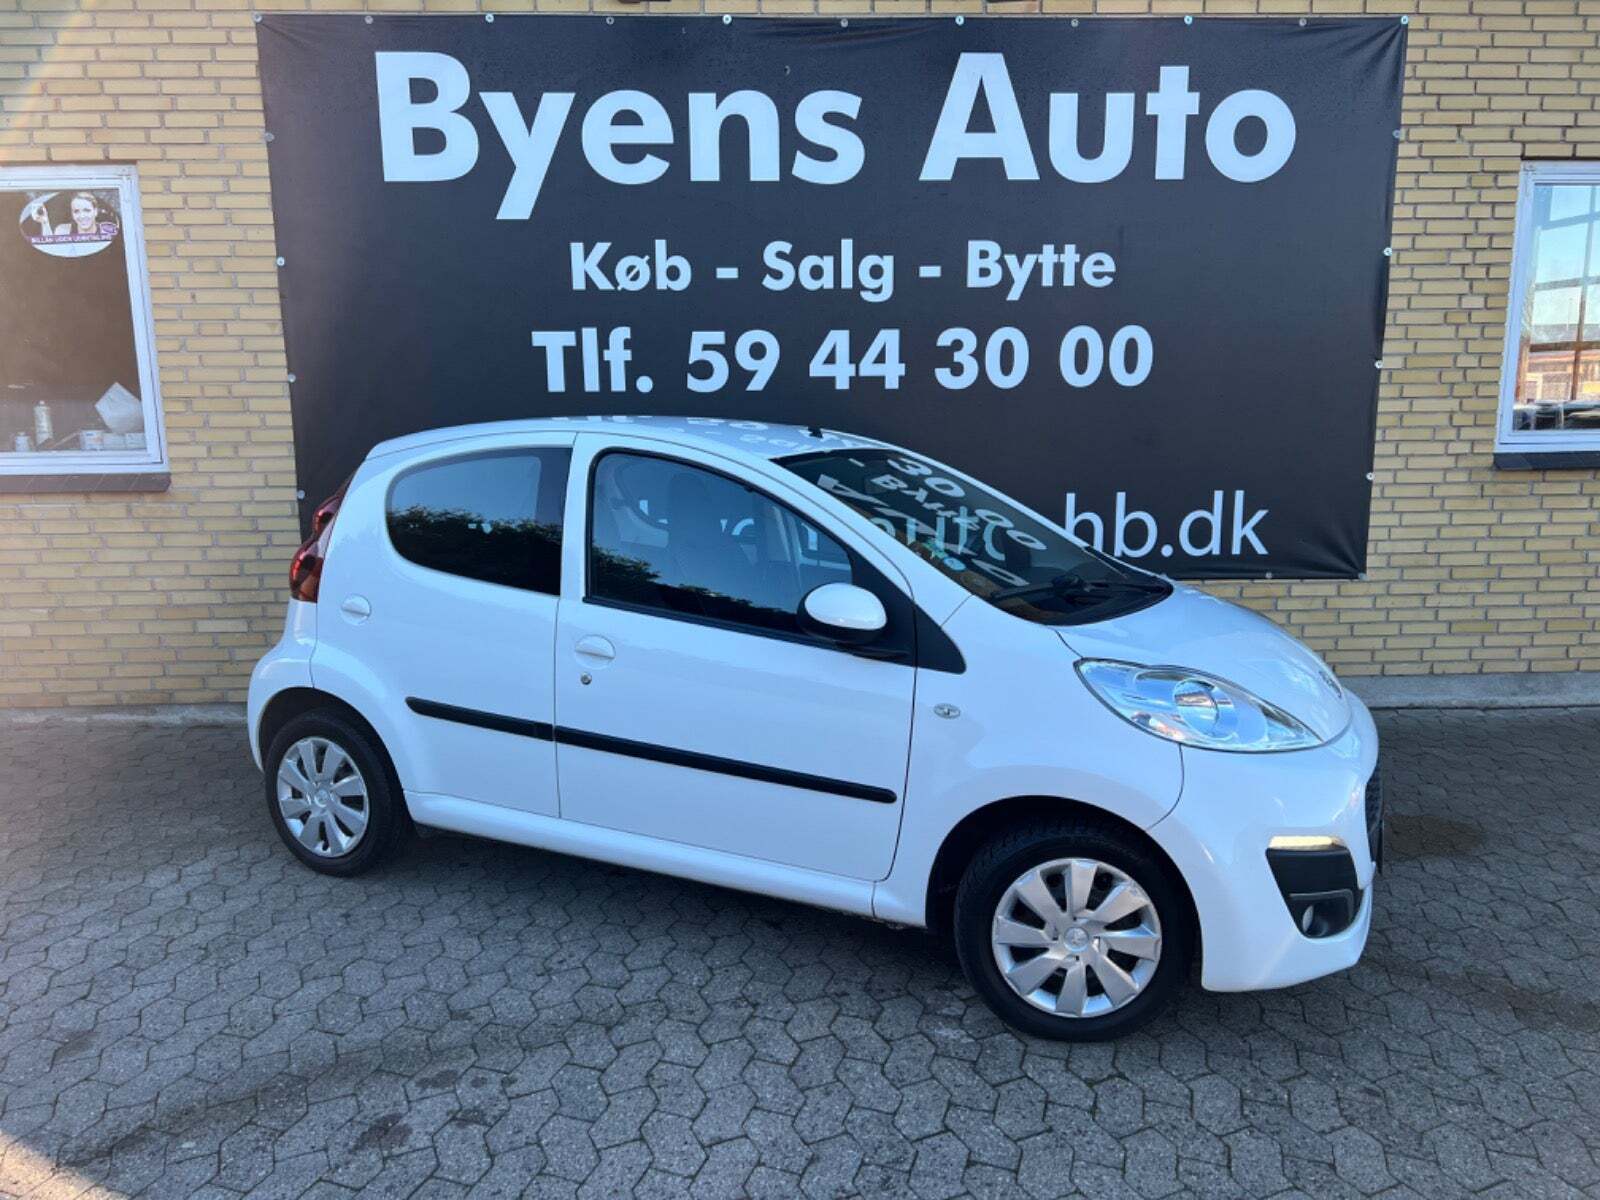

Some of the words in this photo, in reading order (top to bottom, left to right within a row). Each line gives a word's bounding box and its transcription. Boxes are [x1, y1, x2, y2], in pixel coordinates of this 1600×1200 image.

[375, 51, 865, 220] Byens
[919, 52, 1297, 183] Auto
[570, 240, 691, 292] Køb
[716, 268, 738, 278] -
[762, 239, 893, 303] Salg
[919, 266, 942, 277] -
[967, 240, 1117, 301] Bytte
[532, 327, 654, 393] Tlf.
[687, 330, 780, 393] 59
[810, 329, 905, 390] 44
[935, 327, 1030, 390] 30
[1060, 325, 1154, 388] 00
[1064, 490, 1268, 559] hb.dk
